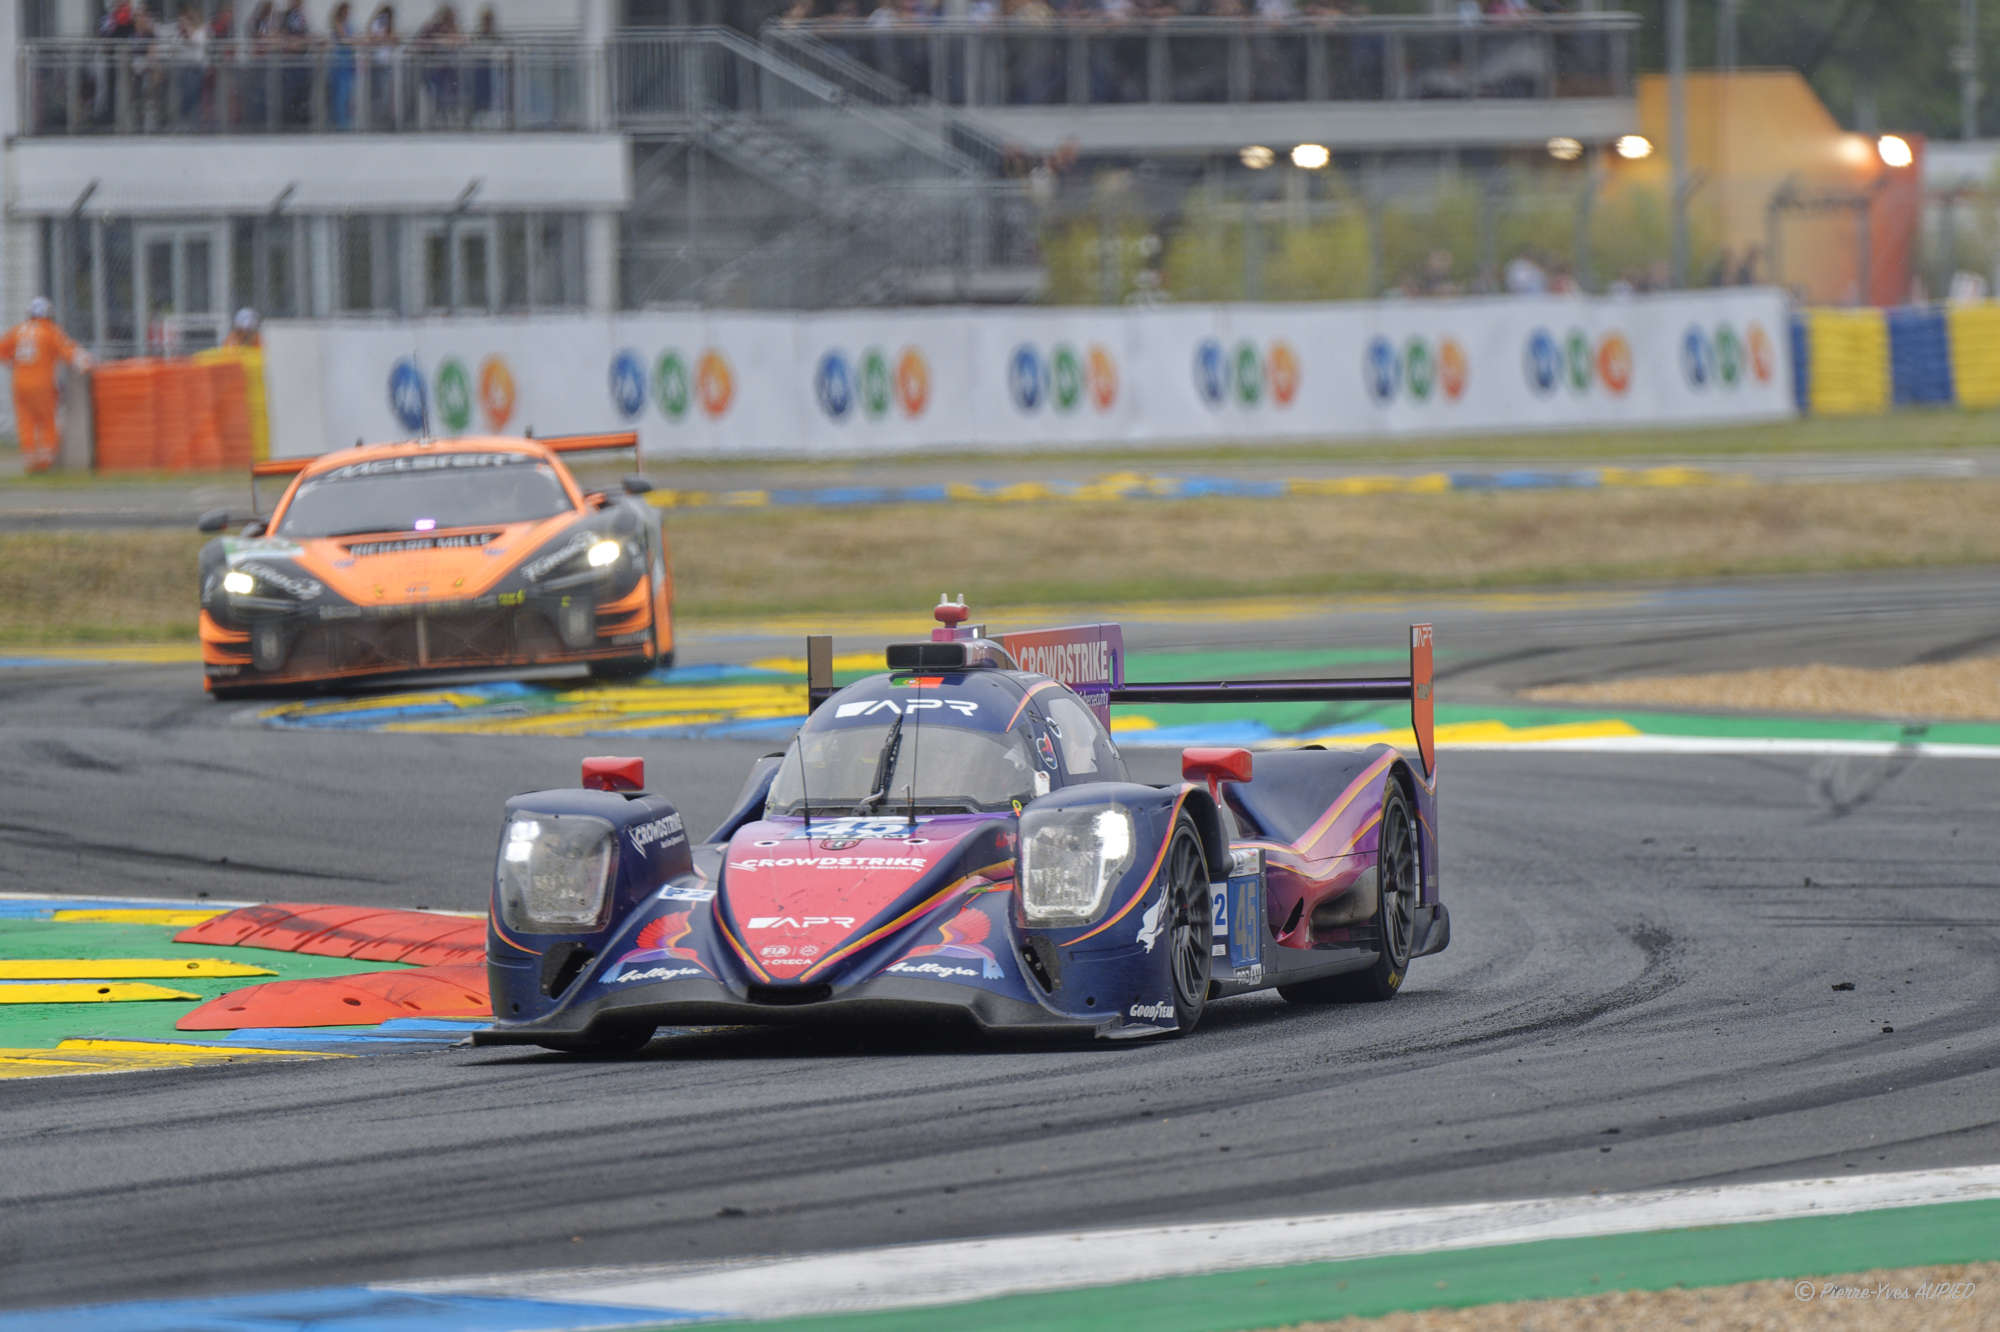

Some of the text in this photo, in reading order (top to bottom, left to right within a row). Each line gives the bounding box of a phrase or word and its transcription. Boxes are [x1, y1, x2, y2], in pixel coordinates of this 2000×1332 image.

[1019, 640, 1109, 684] CROWDSTRIKE
[863, 699, 979, 717] APR
[806, 820, 905, 836] 45
[741, 856, 928, 869] CROWDSTRIKE
[1211, 893, 1227, 926] 2
[770, 916, 856, 929] APR
[1234, 881, 1258, 959] 45
[1129, 1000, 1175, 1022] GOODYEAR
